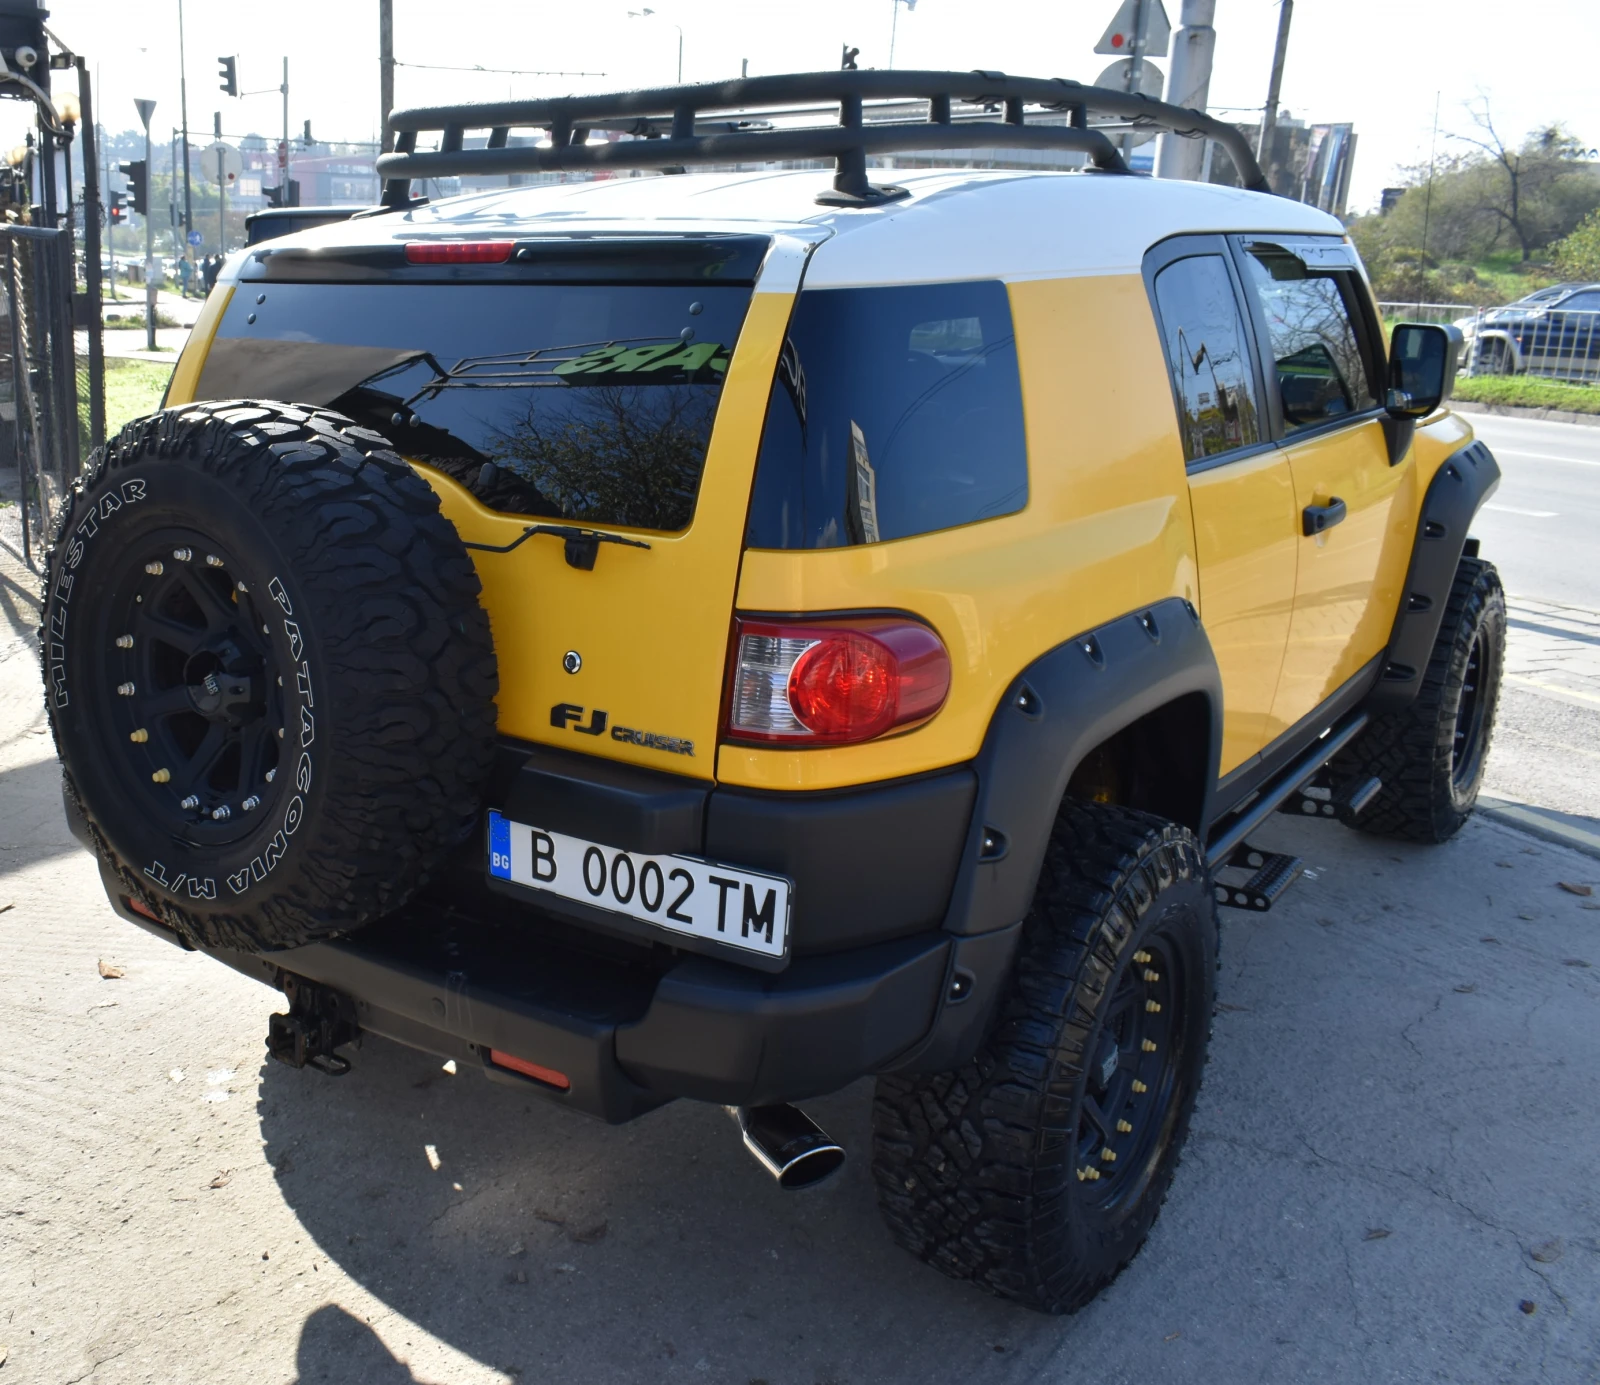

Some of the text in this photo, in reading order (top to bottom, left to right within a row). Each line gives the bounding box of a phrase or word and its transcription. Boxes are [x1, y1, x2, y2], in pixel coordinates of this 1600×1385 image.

[51, 479, 146, 708] MILESTAR
[144, 576, 314, 900] PATAGONIA M/T
[550, 703, 696, 757] FJ CRUISER
[492, 852, 510, 870] BG
